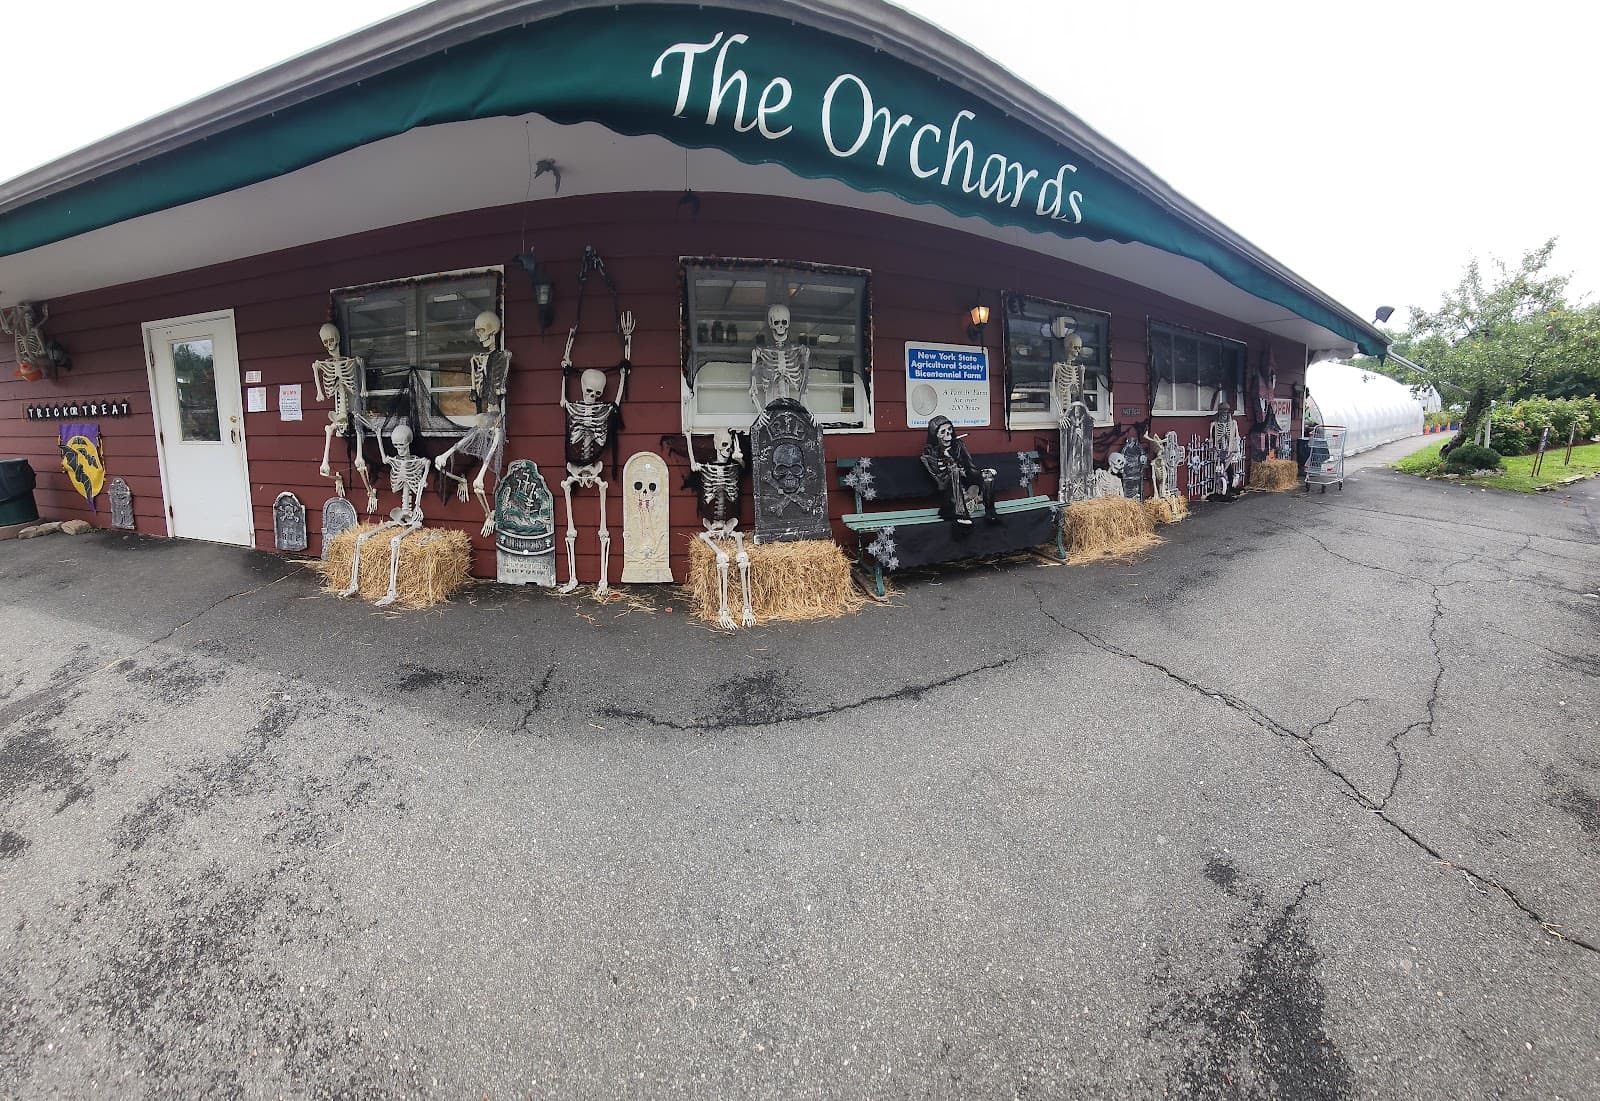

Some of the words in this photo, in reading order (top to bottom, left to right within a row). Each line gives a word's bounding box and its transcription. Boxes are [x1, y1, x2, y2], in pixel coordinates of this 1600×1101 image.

[651, 31, 793, 140] The
[821, 73, 1084, 225] Orchards
[917, 351, 937, 360] New
[939, 352, 956, 361] York
[958, 353, 978, 362] State
[911, 359, 956, 370] Agricultural
[958, 362, 985, 373] Society
[915, 369, 961, 378] Bicentennial
[963, 371, 982, 379] Farm
[28, 406, 68, 418] TRICK
[82, 403, 128, 415] TREAT
